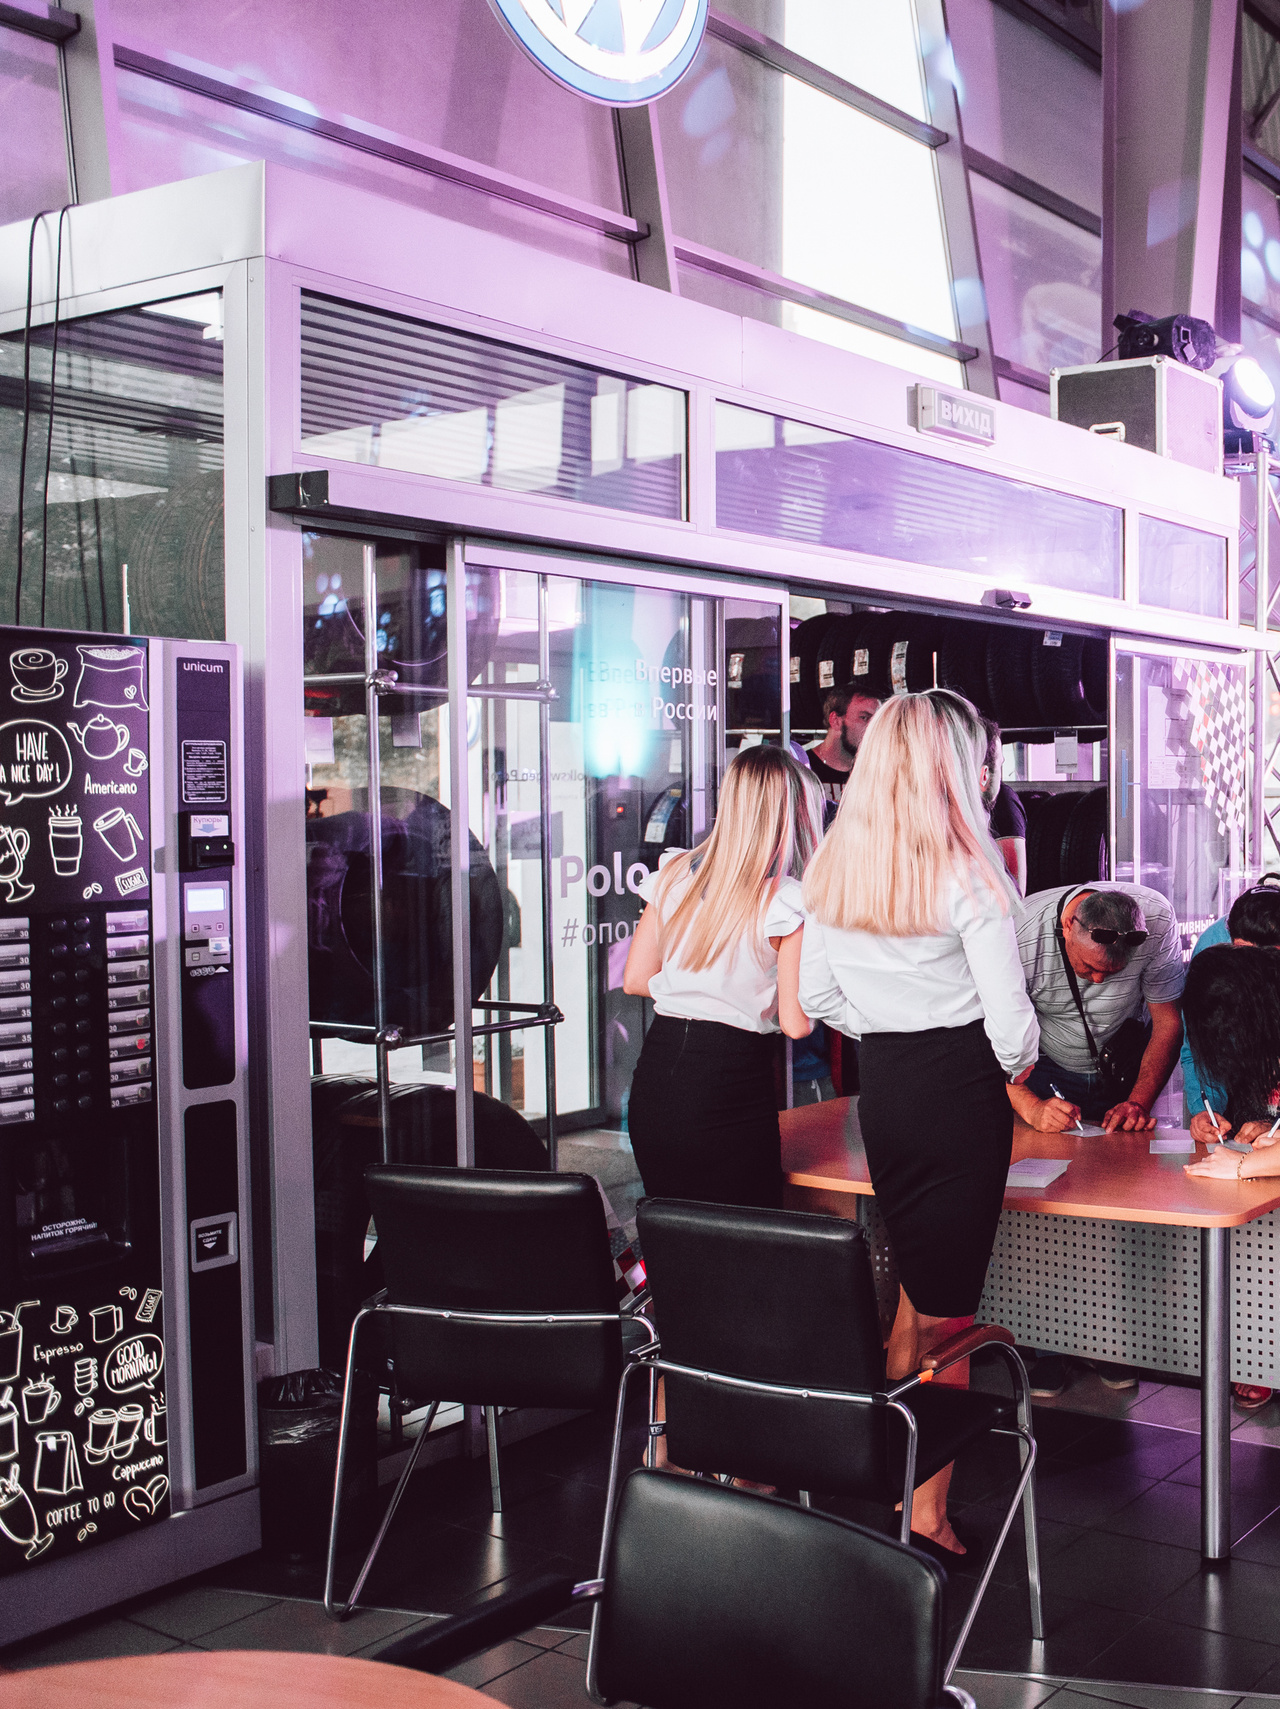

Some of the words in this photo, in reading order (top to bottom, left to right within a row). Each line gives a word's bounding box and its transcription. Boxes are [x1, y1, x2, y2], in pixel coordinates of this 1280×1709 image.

[941, 399, 992, 437] ВИХІД
[183, 661, 224, 673] unicum
[635, 659, 717, 688] Впервые
[652, 697, 717, 721] России
[16, 732, 49, 761] HAVE
[11, 764, 30, 783] NICE
[36, 762, 61, 783] DAY!
[84, 773, 138, 794] Americano
[121, 873, 144, 890] SUGAR
[560, 851, 650, 898] Polo
[19, 930, 29, 938] 30
[20, 982, 30, 990] 30
[108, 975, 117, 983] 35
[21, 1009, 31, 1017] 35
[109, 1000, 117, 1008] 35
[21, 1034, 32, 1042] 35
[22, 1060, 33, 1068] 40
[23, 1086, 34, 1094] 40
[111, 1099, 120, 1107] 30
[24, 1111, 35, 1120] 30
[31, 1229, 64, 1241] НАПИТОК
[141, 1294, 158, 1317] SUGAR
[33, 1342, 84, 1365] Espresso
[116, 1340, 145, 1366] GOOD
[111, 1351, 158, 1386] MORNING!
[112, 1454, 164, 1481] Cappuccino
[46, 1502, 82, 1528] COFFEE
[87, 1496, 100, 1514] TO
[103, 1491, 116, 1509] GO
